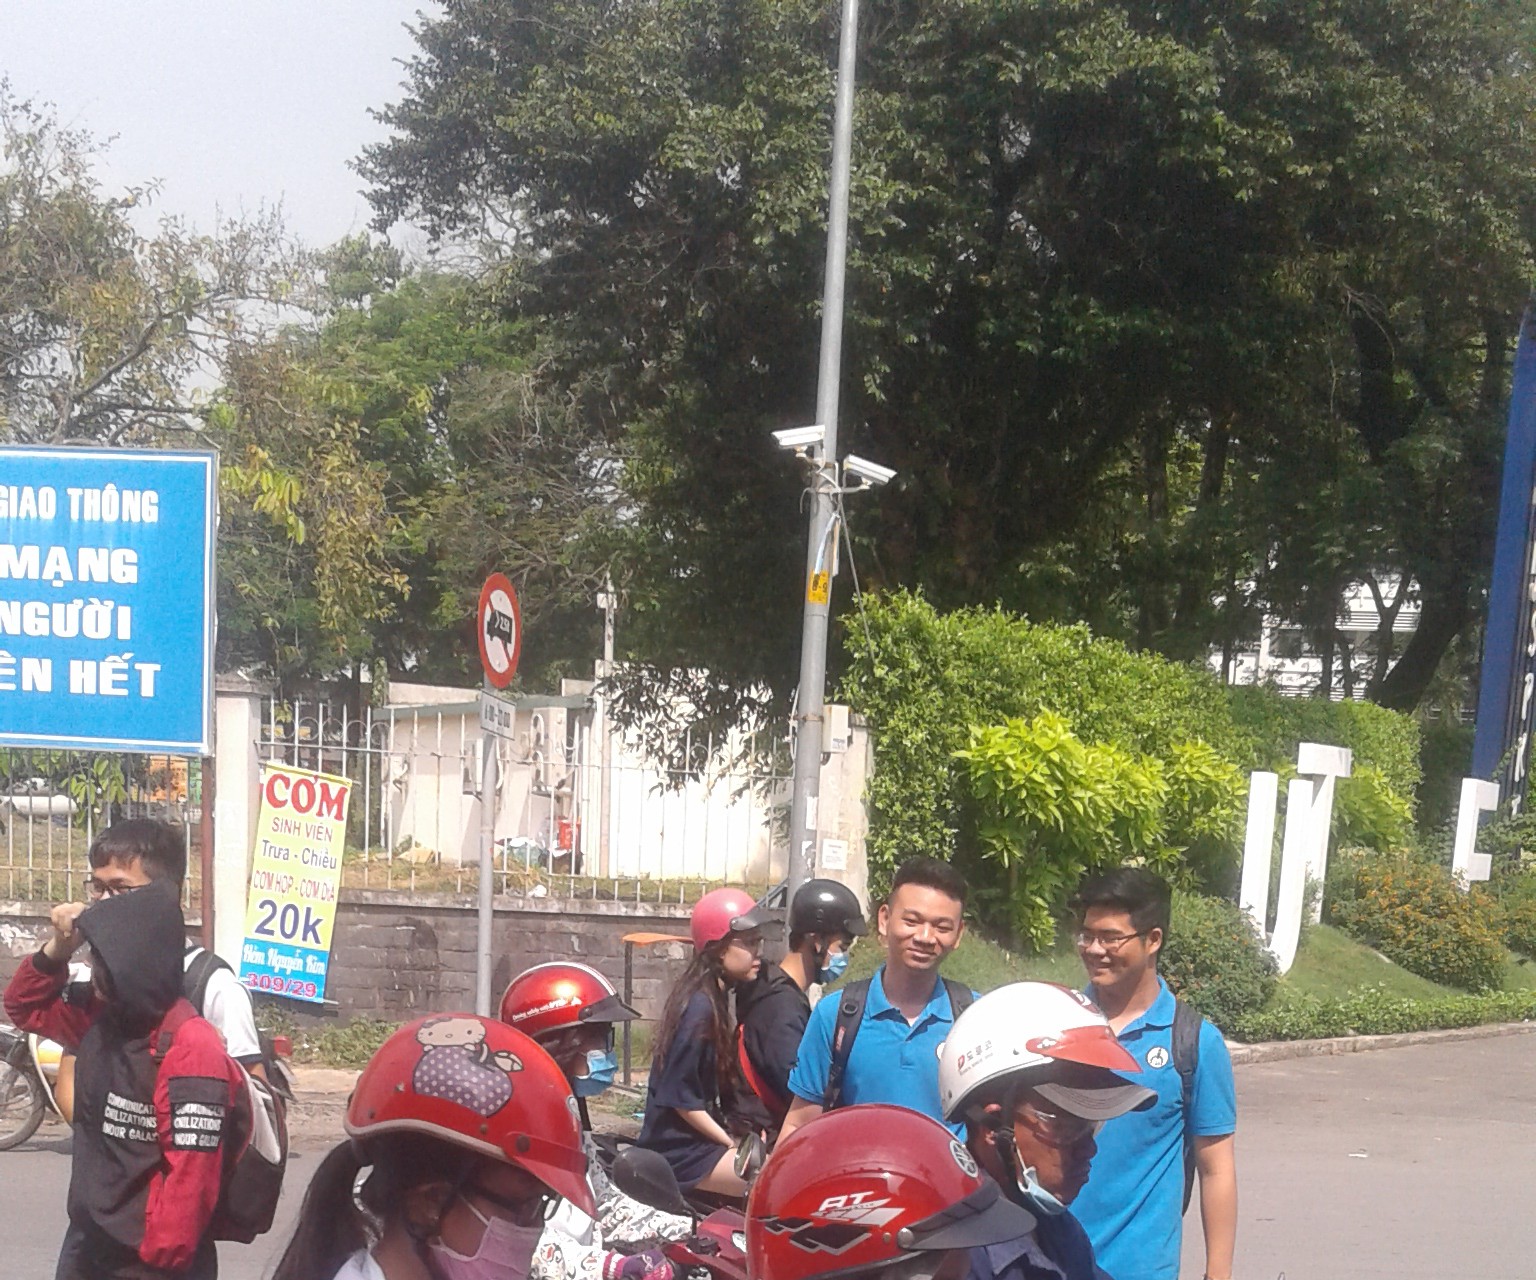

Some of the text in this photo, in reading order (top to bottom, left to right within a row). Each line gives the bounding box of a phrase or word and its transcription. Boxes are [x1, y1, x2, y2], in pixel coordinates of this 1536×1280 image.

[67, 483, 159, 523] THÔNG
[0, 544, 138, 588] MẠNG
[0, 597, 131, 640] NGƯỜI
[69, 652, 161, 698] HẾT
[265, 774, 349, 822] CƠM
[262, 839, 290, 861] Trưa
[271, 816, 333, 843] SINH VIÊN
[246, 973, 317, 997] 309/29
